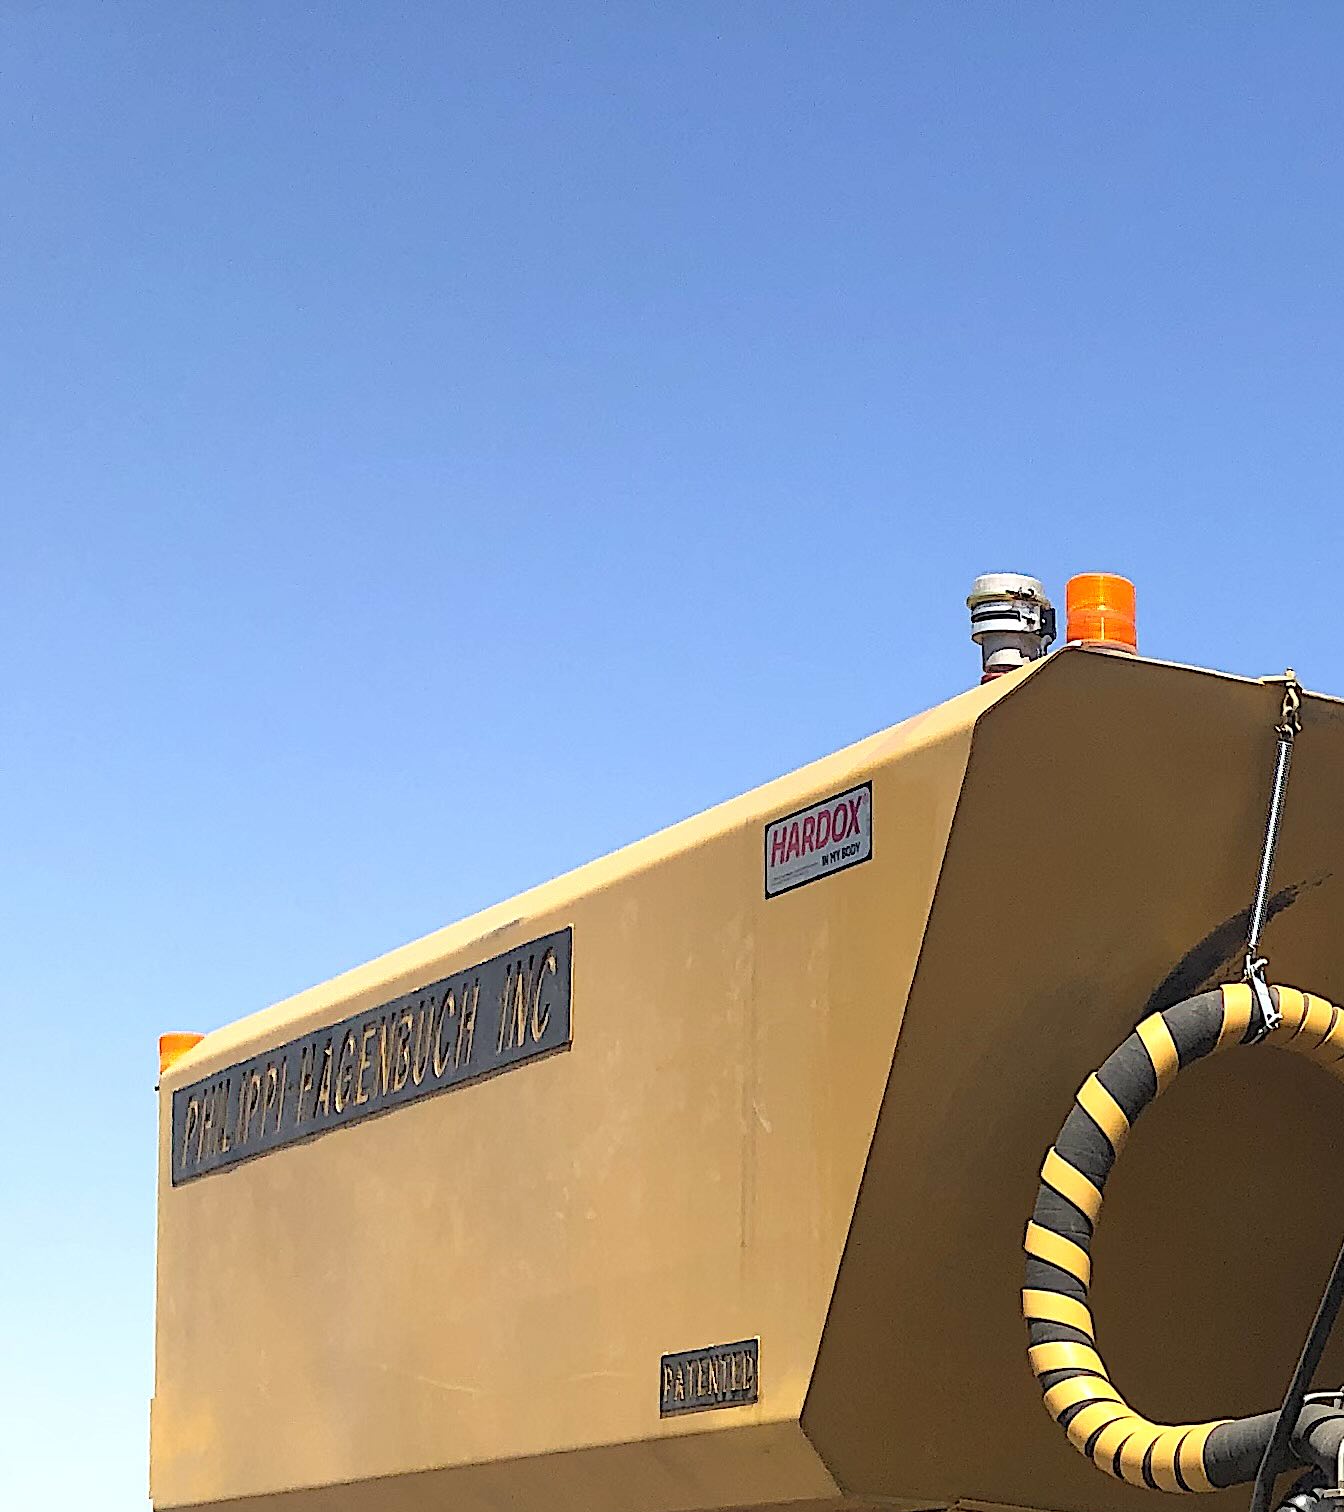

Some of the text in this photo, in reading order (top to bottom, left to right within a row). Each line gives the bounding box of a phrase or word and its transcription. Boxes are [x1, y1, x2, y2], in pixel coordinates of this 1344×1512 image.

[771, 795, 862, 867] HARDOX
[841, 842, 861, 859] BODY
[296, 977, 481, 1126] HAGENBUCH
[497, 946, 559, 1056] INC
